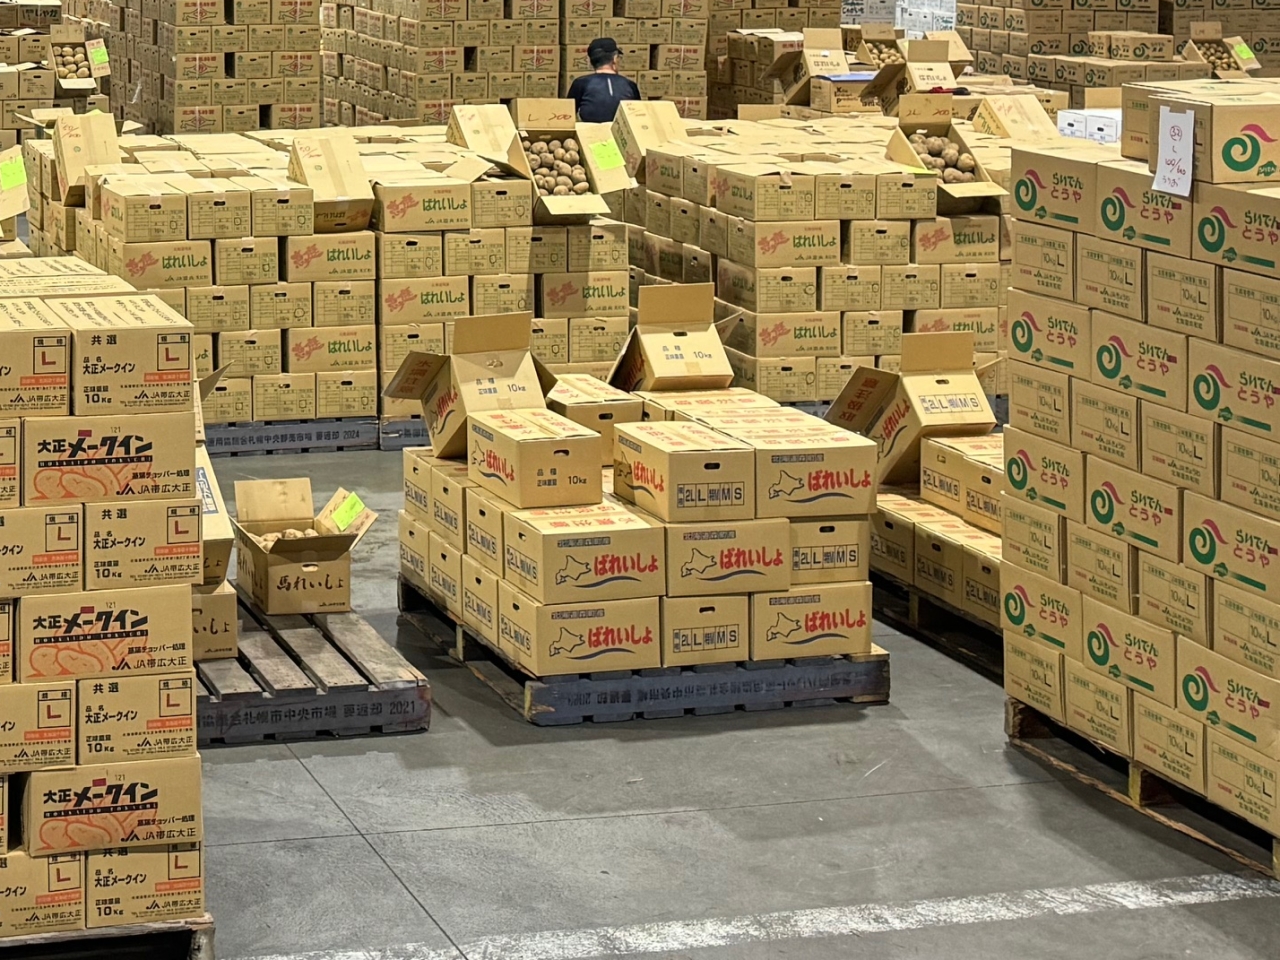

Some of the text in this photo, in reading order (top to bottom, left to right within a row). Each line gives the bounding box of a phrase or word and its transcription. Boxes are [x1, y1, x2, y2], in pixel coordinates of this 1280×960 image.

[1051, 188, 1082, 203] とうや
[423, 196, 468, 213] ばれいしょ
[793, 233, 837, 249] ばれいしょ
[161, 254, 208, 270] ばれいしょ
[328, 249, 372, 264] ばれいしょ
[1057, 254, 1064, 266] L
[1125, 272, 1133, 286] L
[421, 290, 466, 305] ばれいしょ
[582, 284, 626, 299] ばれいしょ
[1198, 293, 1207, 305] L
[328, 340, 372, 355] ばれいしょ
[1047, 332, 1077, 347] とうや
[41, 351, 56, 365] L
[342, 430, 360, 440] 2024
[38, 435, 153, 458] 大正メークイン
[486, 450, 515, 481] ばれいしょ
[568, 475, 587, 485] 10kg
[633, 460, 665, 492] ばれいしょ
[808, 468, 872, 489] ばれいしょ
[1040, 473, 1068, 489] とうや
[138, 483, 191, 494] JA帯広大正
[697, 487, 707, 502] L
[721, 485, 732, 501] M
[733, 483, 743, 500] S
[594, 553, 659, 575] ばれいしょ
[720, 546, 783, 568] ばれいしょ
[276, 575, 344, 591] 馬れいしょ
[33, 610, 148, 633] 大正メークイン
[804, 608, 866, 630] ばれいしょ
[1039, 609, 1068, 627] とうや
[588, 624, 653, 647] ばれいしょ
[1124, 649, 1157, 669] とうや
[389, 700, 416, 715] 2021
[85, 710, 138, 724] 大正メークイン
[43, 782, 158, 807] 大正メークイン
